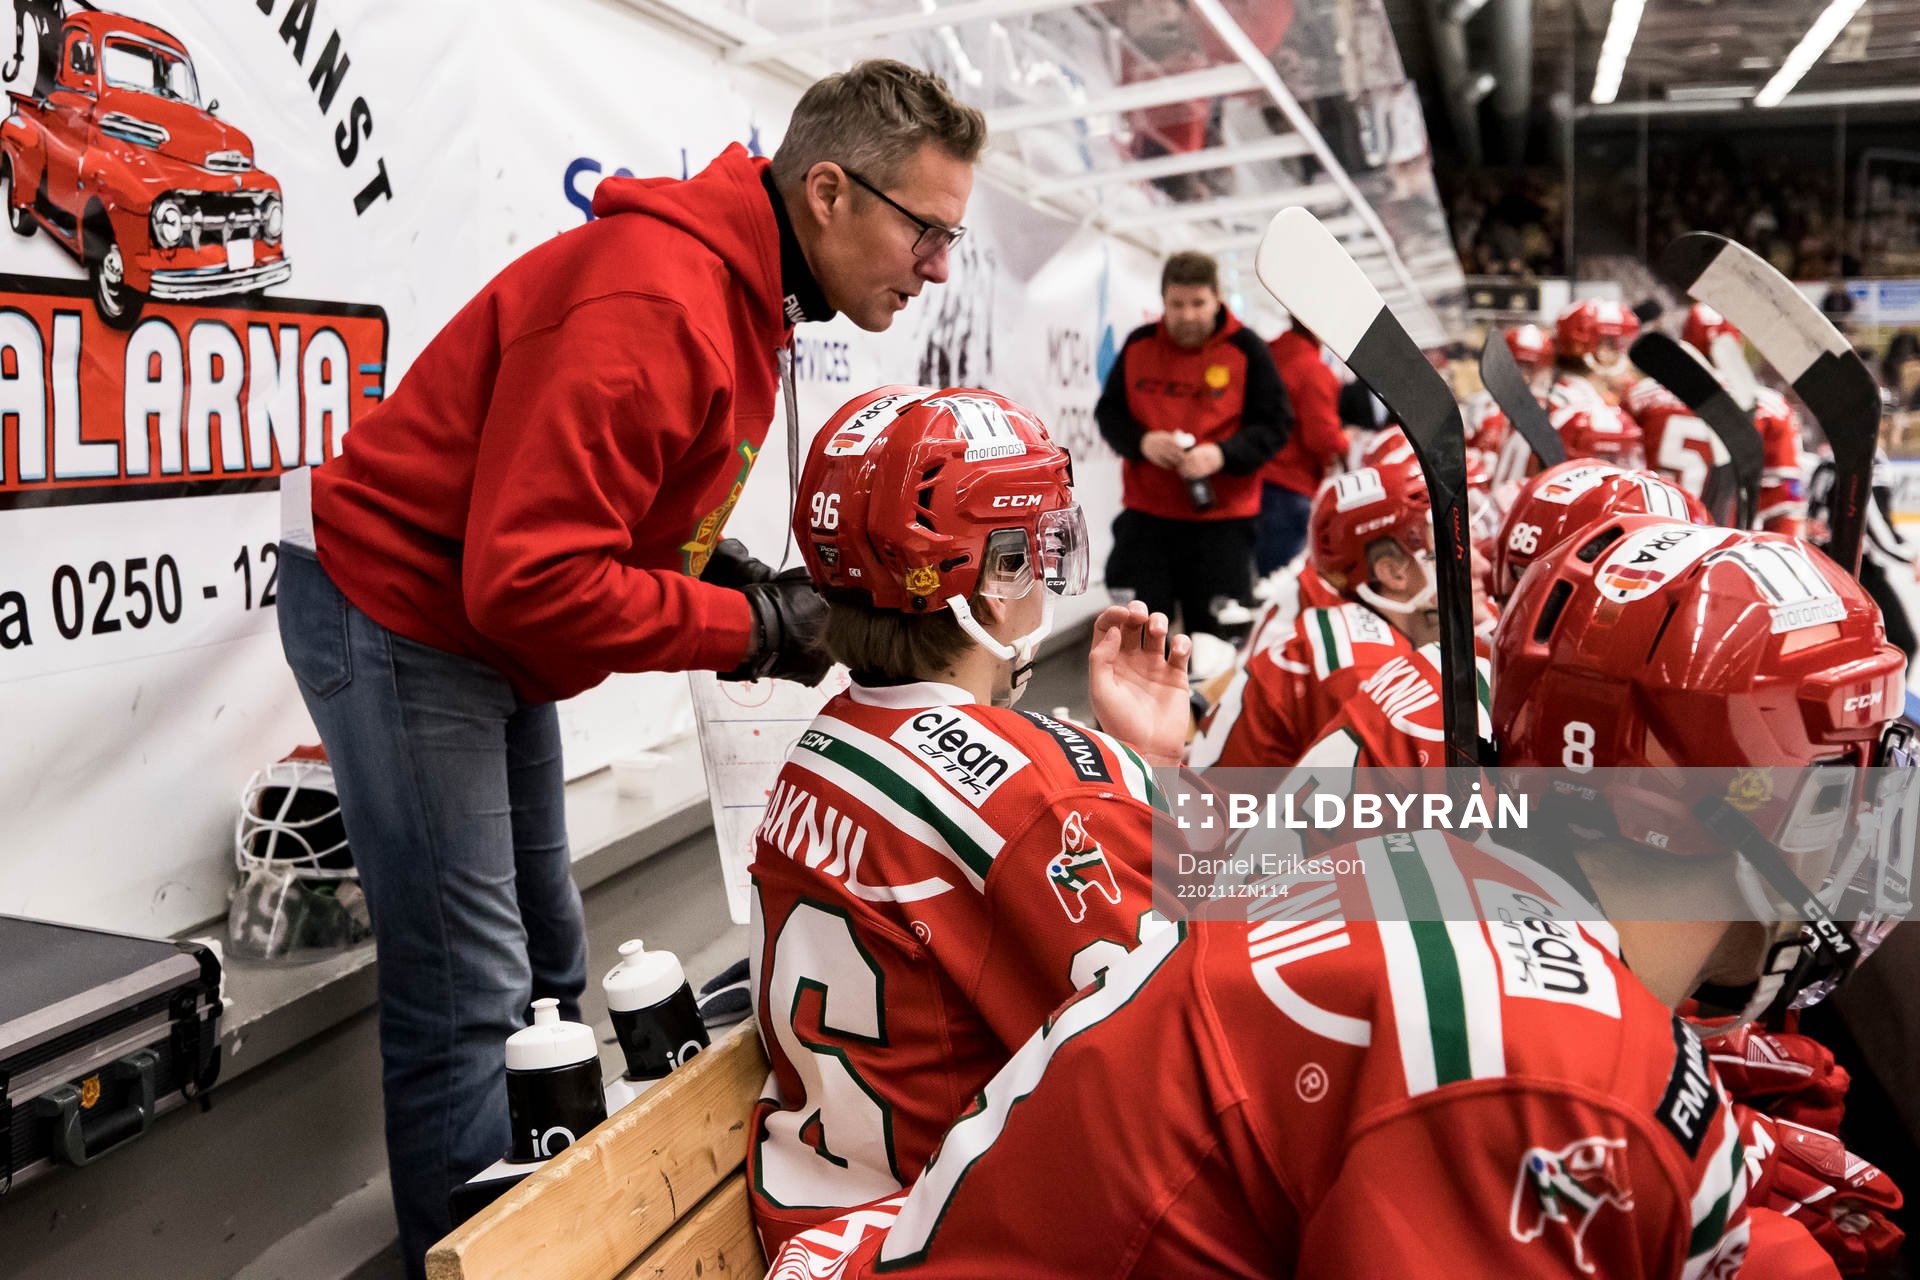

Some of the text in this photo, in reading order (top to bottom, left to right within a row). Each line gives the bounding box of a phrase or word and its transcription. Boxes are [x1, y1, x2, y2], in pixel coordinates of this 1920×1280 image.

[810, 491, 840, 530] 96
[992, 494, 1042, 508] CCM
[1354, 513, 1397, 536] CCM
[1509, 521, 1543, 555] 86
[52, 554, 183, 640] 0250
[1047, 580, 1066, 588] CCM
[1844, 690, 1883, 712] CCM
[912, 713, 1008, 787] clean
[1562, 720, 1596, 774] 8
[918, 743, 987, 795] drink
[1884, 875, 1906, 894] CCM
[1511, 893, 1589, 995] clean
[1803, 898, 1852, 953] CCM
